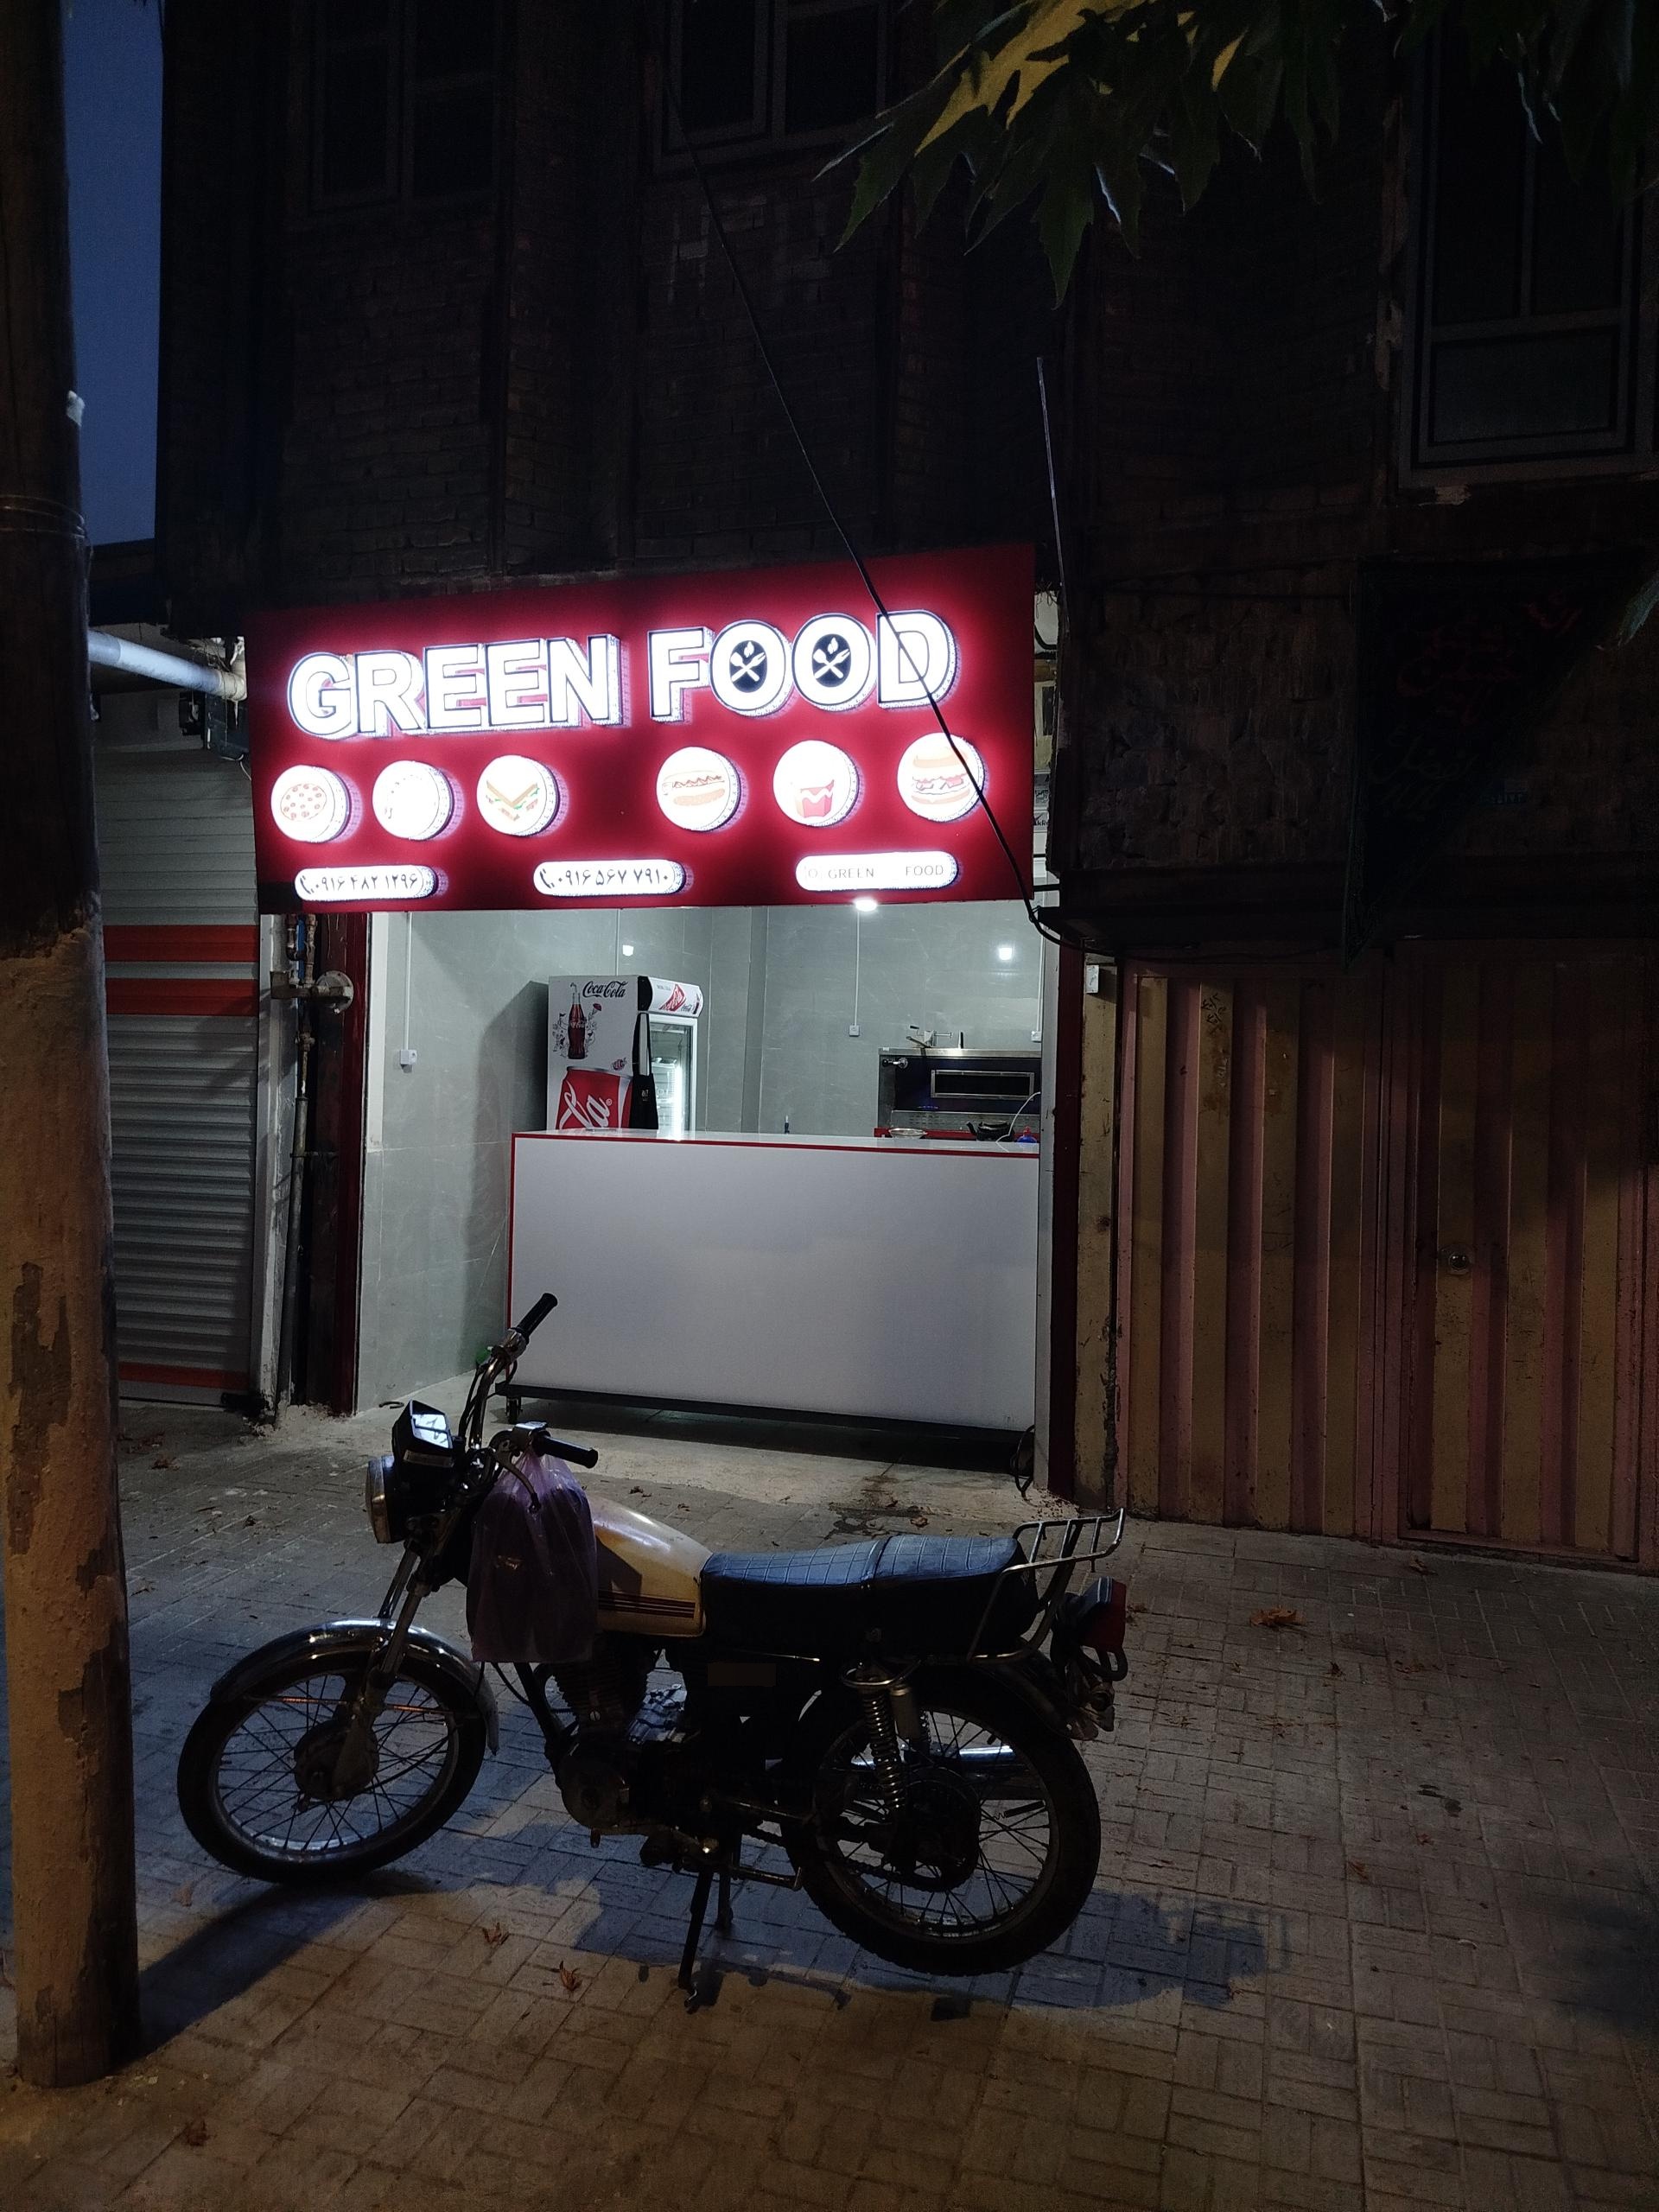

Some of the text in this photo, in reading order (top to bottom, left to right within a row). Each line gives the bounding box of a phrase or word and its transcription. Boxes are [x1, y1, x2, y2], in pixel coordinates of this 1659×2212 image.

[287, 609, 957, 740] GREEN FOOD
[558, 868, 668, 886] ۰۹۱۶ ۵۶۷ ۷۹۱۰
[828, 864, 944, 880] GREEN FOOD
[315, 875, 346, 891] ۰۹۱۶
